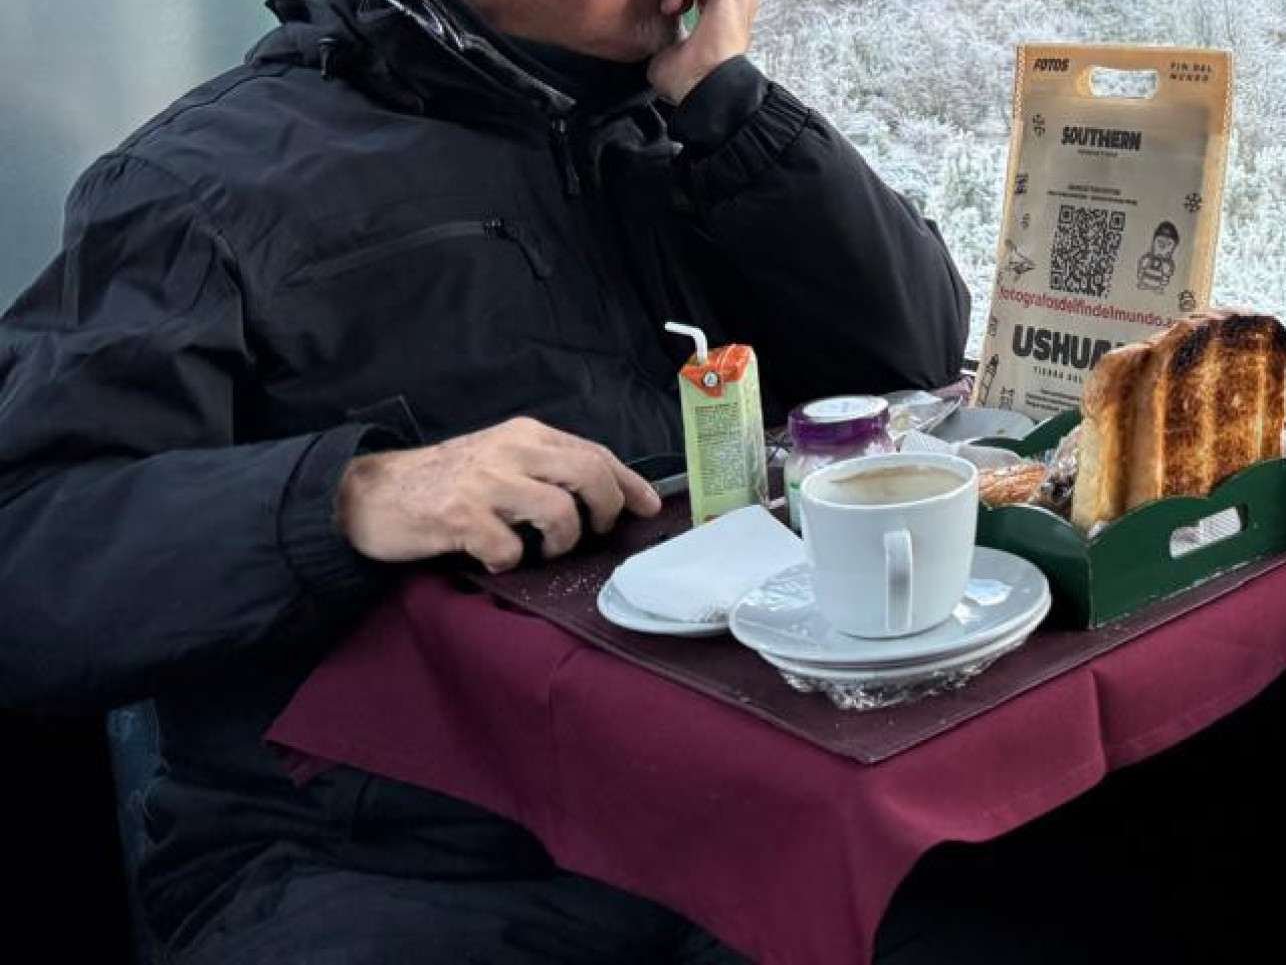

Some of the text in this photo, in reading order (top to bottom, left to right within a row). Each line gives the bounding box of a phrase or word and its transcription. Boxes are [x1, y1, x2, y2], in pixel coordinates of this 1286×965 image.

[1033, 58, 1070, 72] FOTOS
[1061, 126, 1142, 151] SOUTHERN
[1013, 324, 1124, 371] USHUA
